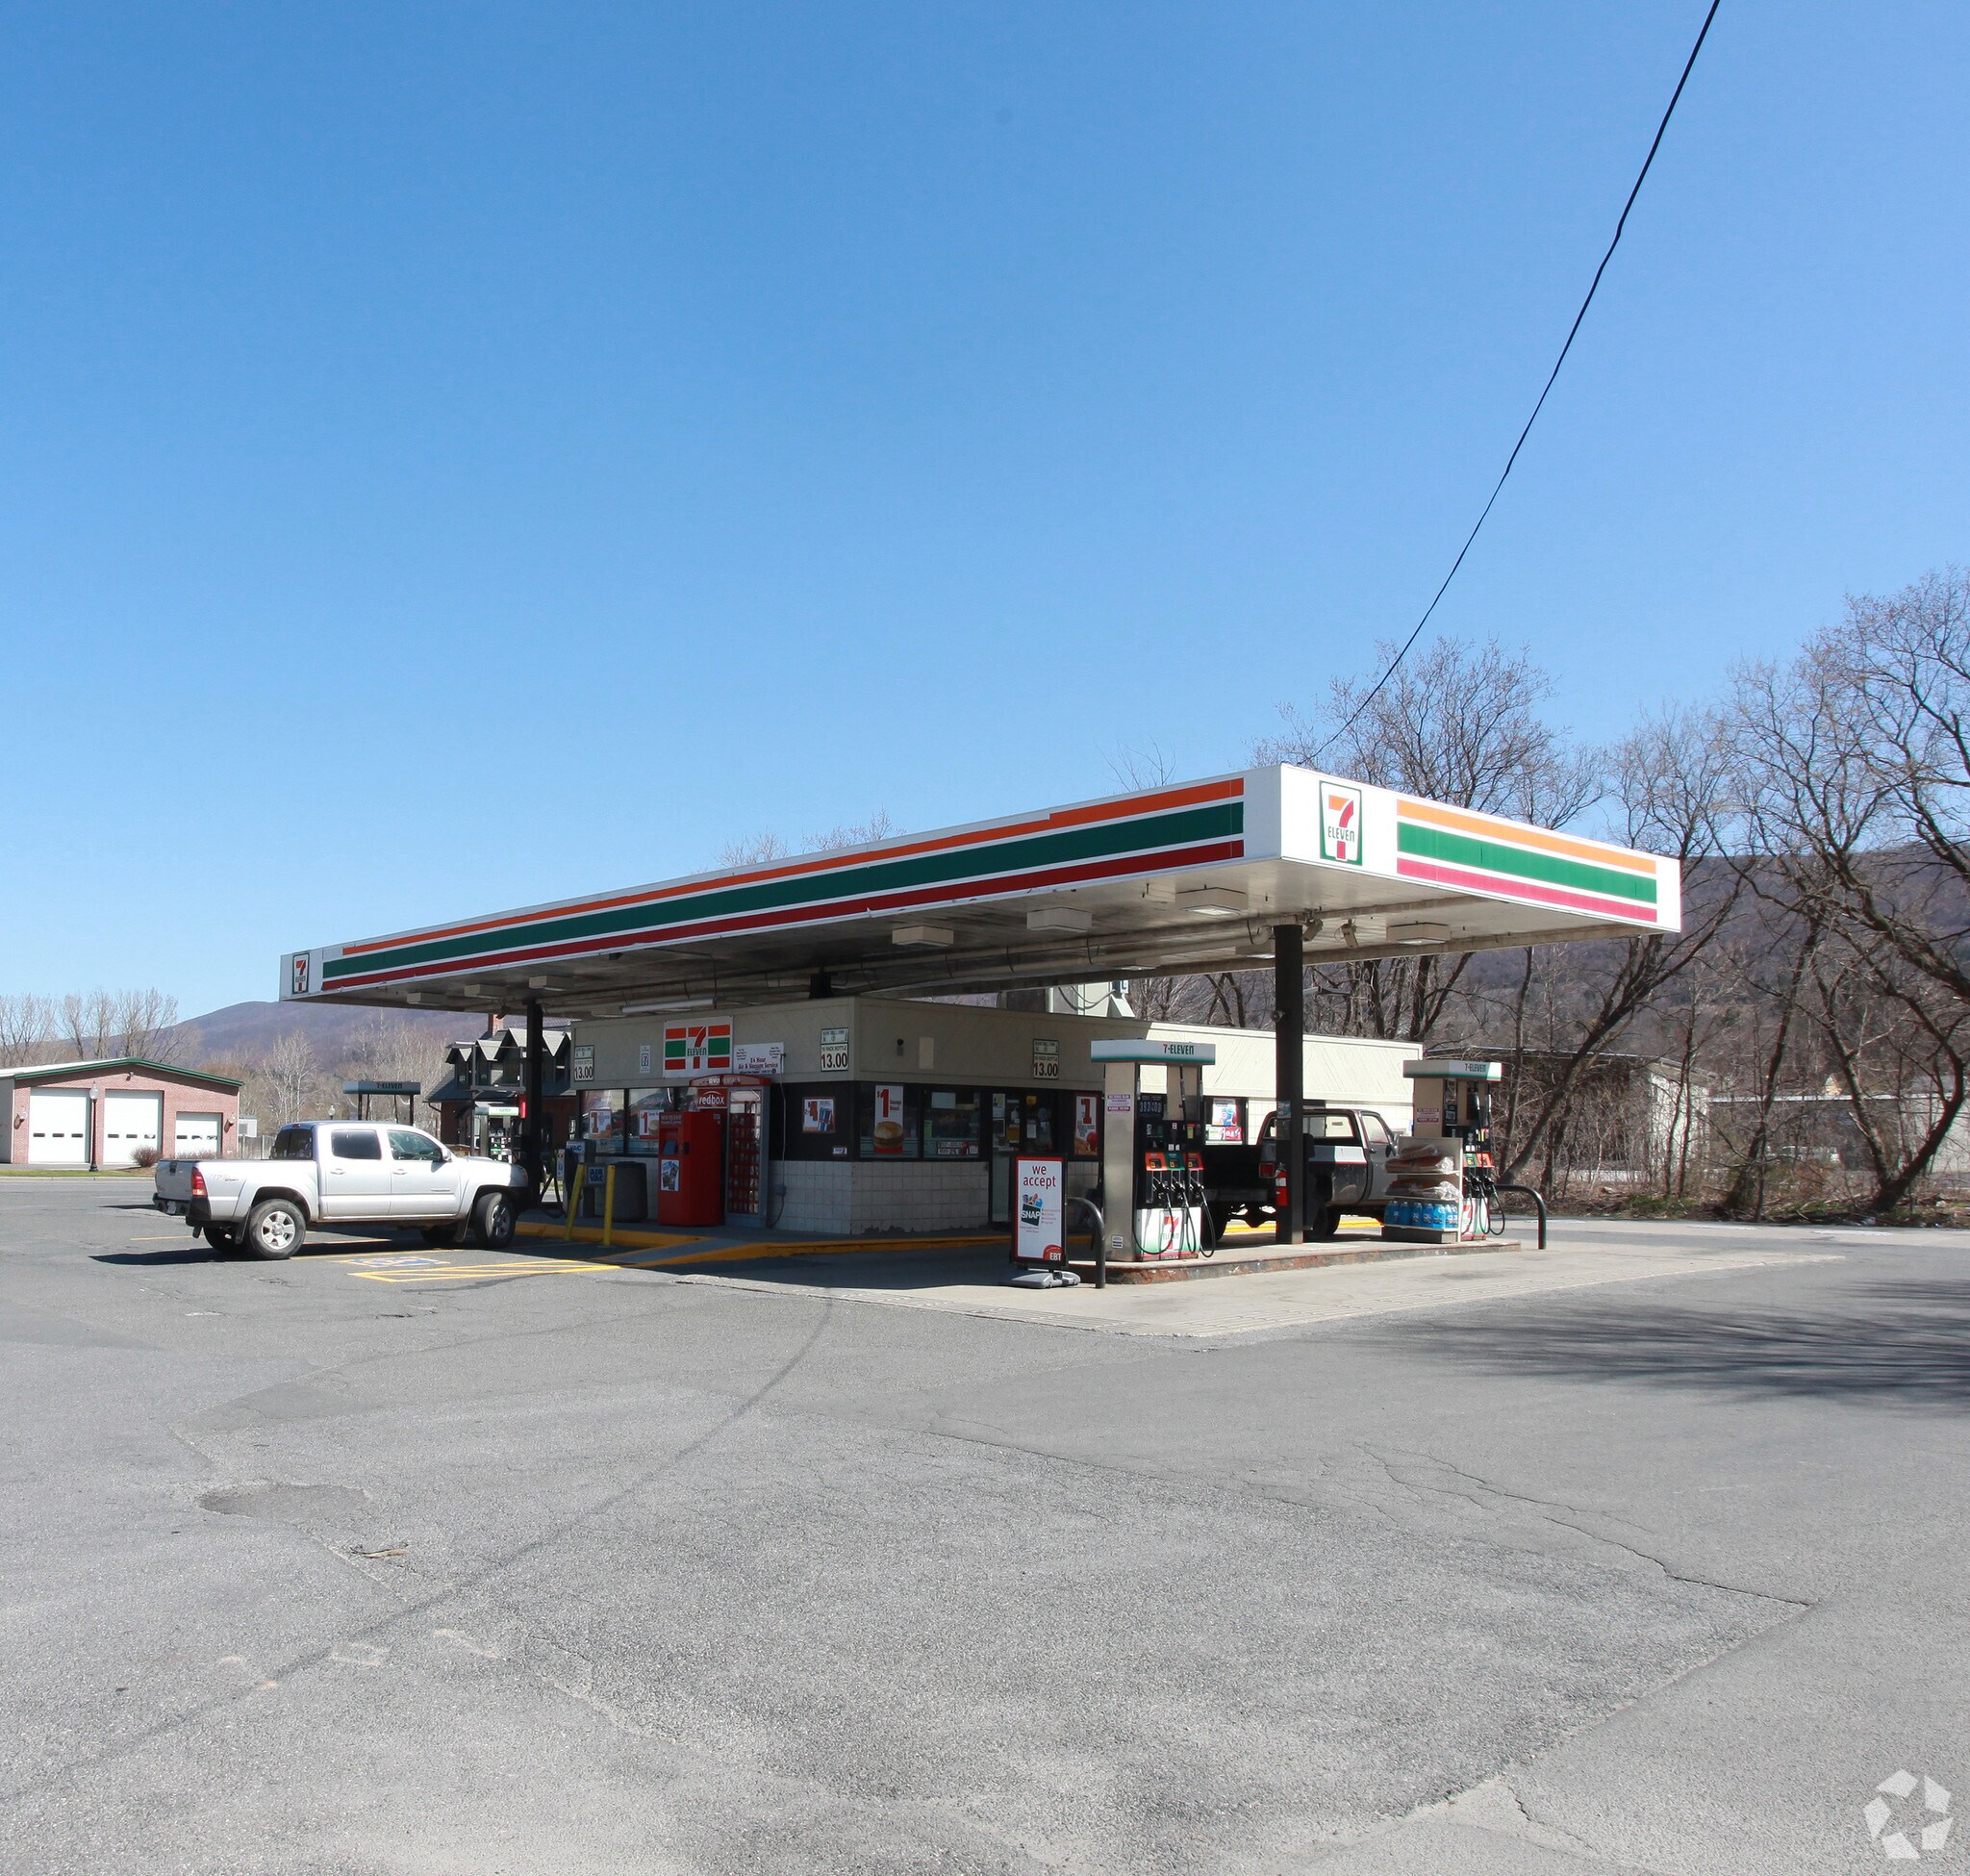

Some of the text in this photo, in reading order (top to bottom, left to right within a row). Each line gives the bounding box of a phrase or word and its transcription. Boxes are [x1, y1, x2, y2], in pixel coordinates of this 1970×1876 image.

[1328, 795, 1354, 859] 7
[1327, 826, 1355, 842] ELEVEN
[687, 1048, 707, 1056] ELEVEN
[1163, 1044, 1195, 1055] 7-ELEVEN
[821, 1052, 847, 1068] 13.00
[574, 1066, 594, 1078] 13.00
[1033, 1062, 1058, 1077] 13.00
[698, 1094, 725, 1104] redbox
[1031, 1165, 1047, 1176] we
[1023, 1176, 1056, 1190] accept
[1021, 1210, 1041, 1220] SNAP
[1049, 1252, 1062, 1261] EBT
